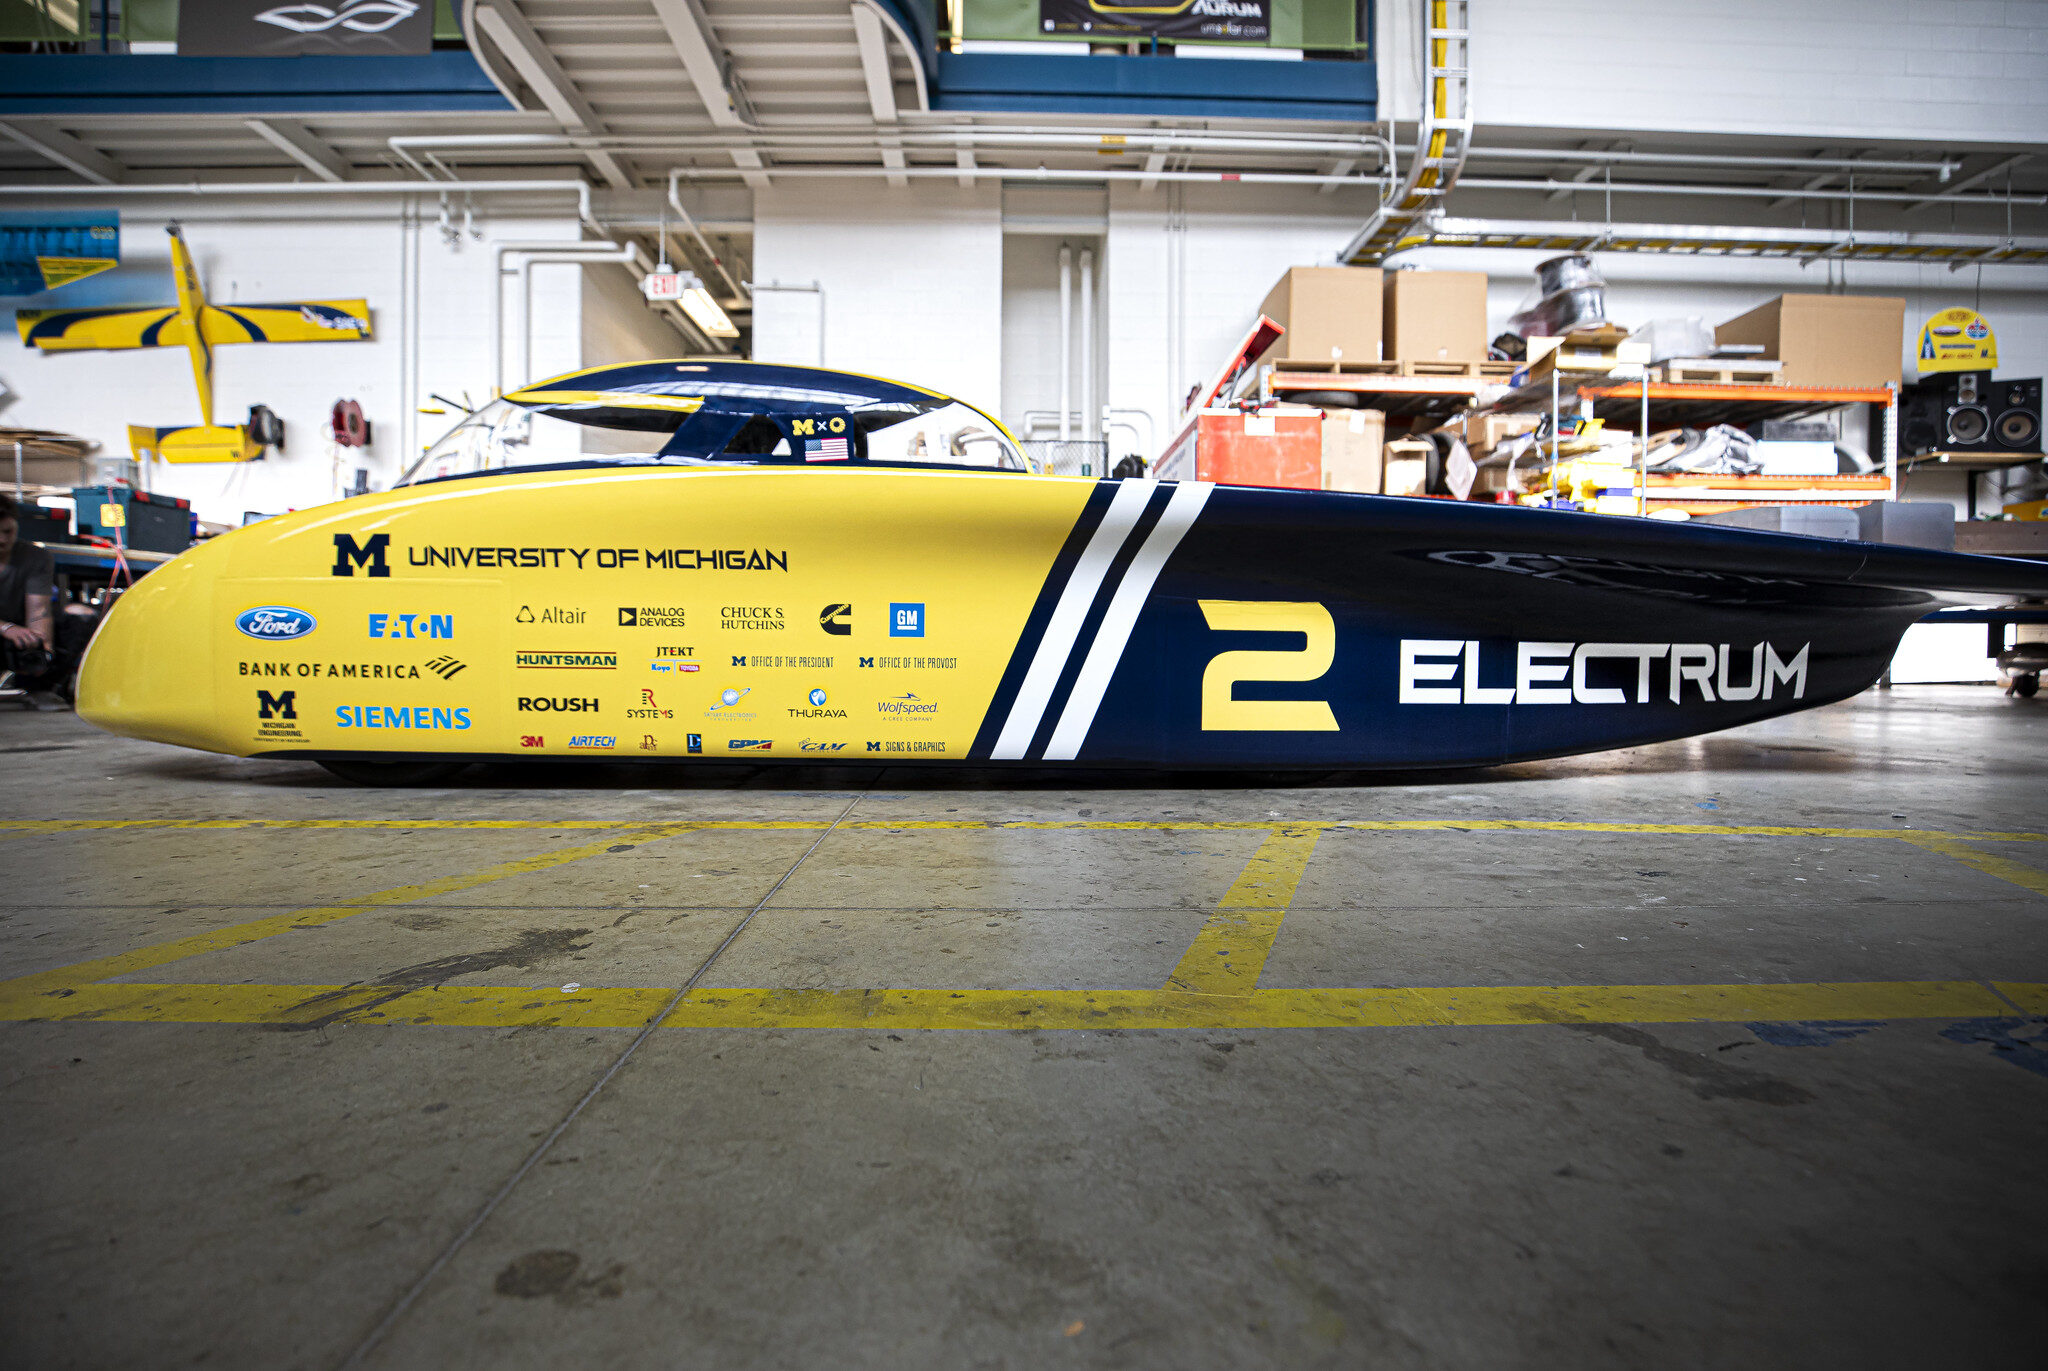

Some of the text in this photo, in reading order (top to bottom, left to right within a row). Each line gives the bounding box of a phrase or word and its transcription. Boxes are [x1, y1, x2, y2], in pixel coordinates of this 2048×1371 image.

[653, 274, 678, 295] EXIT
[792, 418, 815, 436] M
[332, 533, 787, 577] M UNIVERSITY OF MICHIGAN
[541, 607, 586, 624] Altair
[640, 607, 685, 617] ANALOG
[721, 606, 785, 619] CHUCK S.
[896, 609, 918, 626] GM
[248, 609, 302, 636] Ford
[369, 613, 453, 639] EATON
[640, 617, 685, 627] DEVICES
[721, 619, 785, 631] HUTCHINS
[656, 646, 694, 657] JTEKT
[516, 654, 617, 667] HUNTSMAN
[732, 656, 834, 669] M OFFICE OF THE PRESIDENT
[859, 657, 957, 669] M OFFICE OF THE PROVOST
[1197, 599, 1341, 732] 2
[239, 662, 420, 679] BANK OF AMERICA
[651, 663, 671, 673] Koyo
[1399, 639, 1810, 706] ELECTRUM
[256, 689, 297, 719] M
[518, 697, 599, 713] ROUSH
[336, 706, 471, 730] SIEMENS
[626, 709, 673, 720] SYSTEMS
[787, 708, 847, 718] THURAYA
[520, 736, 544, 748] 3M
[568, 735, 616, 747] AIRTECH
[866, 741, 946, 753] M SIGNS & GRAPHICS
